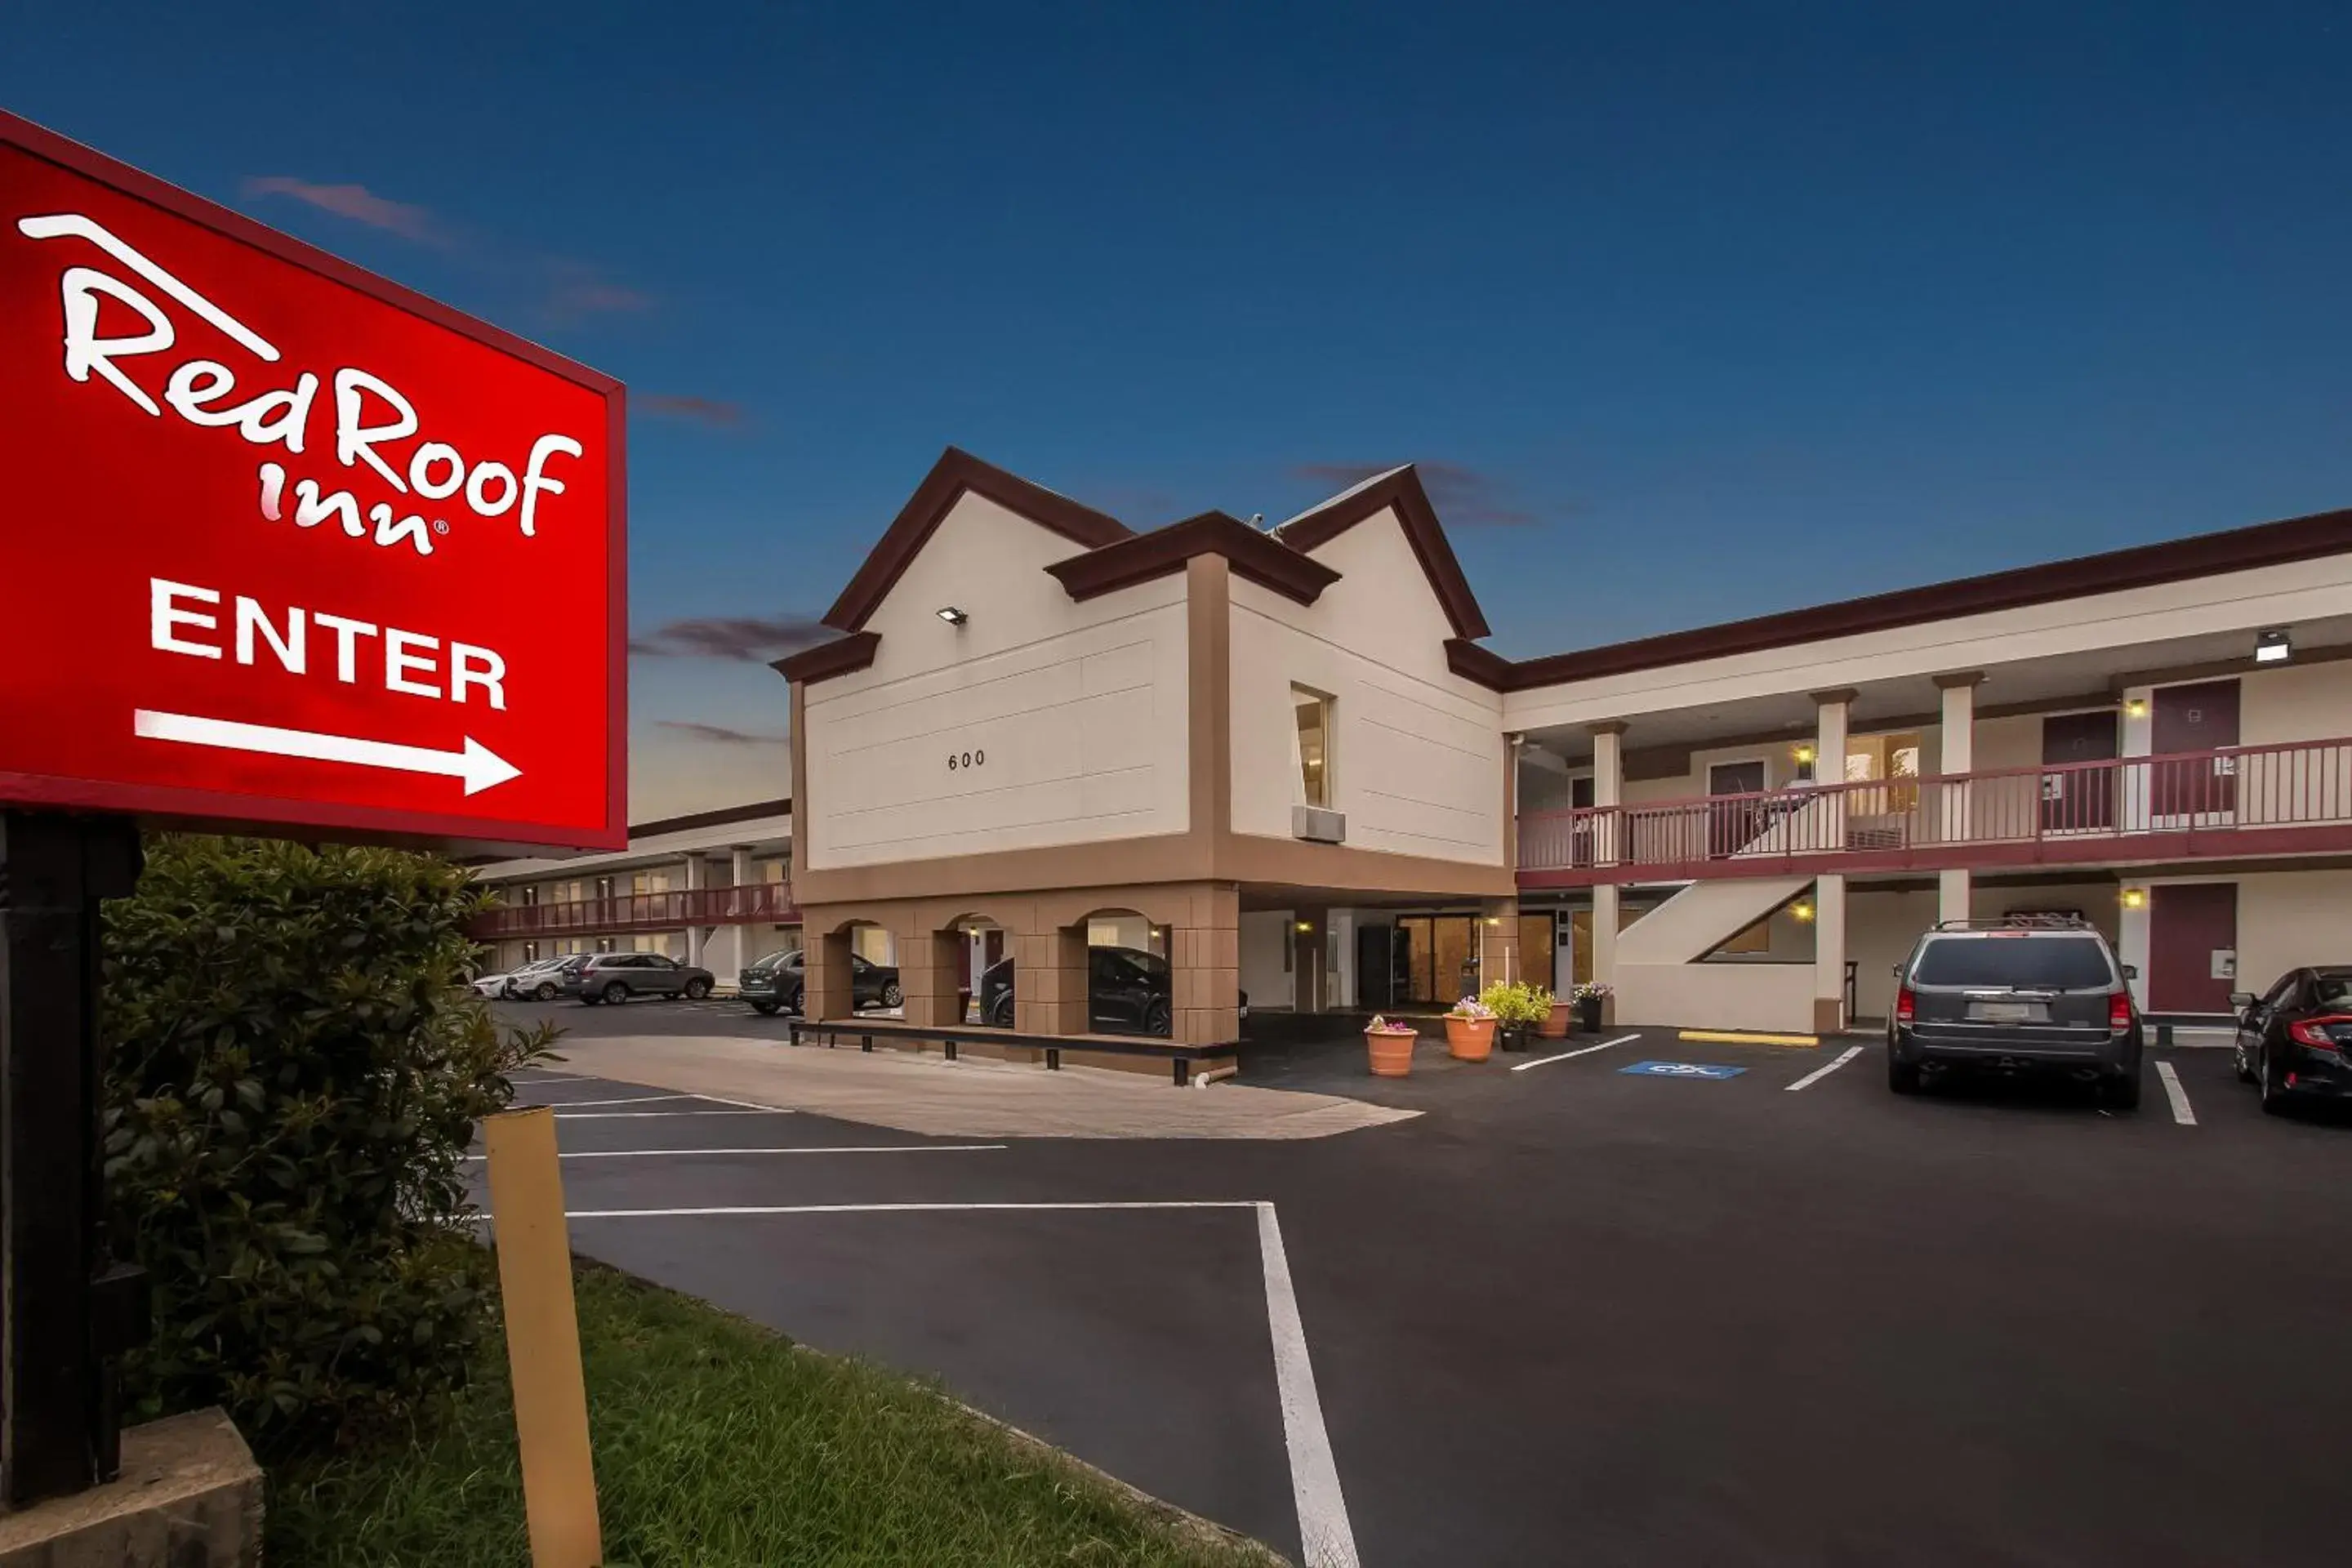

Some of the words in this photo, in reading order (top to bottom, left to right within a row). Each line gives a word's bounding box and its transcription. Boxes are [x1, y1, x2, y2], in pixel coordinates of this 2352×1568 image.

[62, 267, 319, 453] Red
[335, 368, 583, 537] Roof
[149, 577, 506, 710] ENTER
[948, 749, 984, 770] 600
